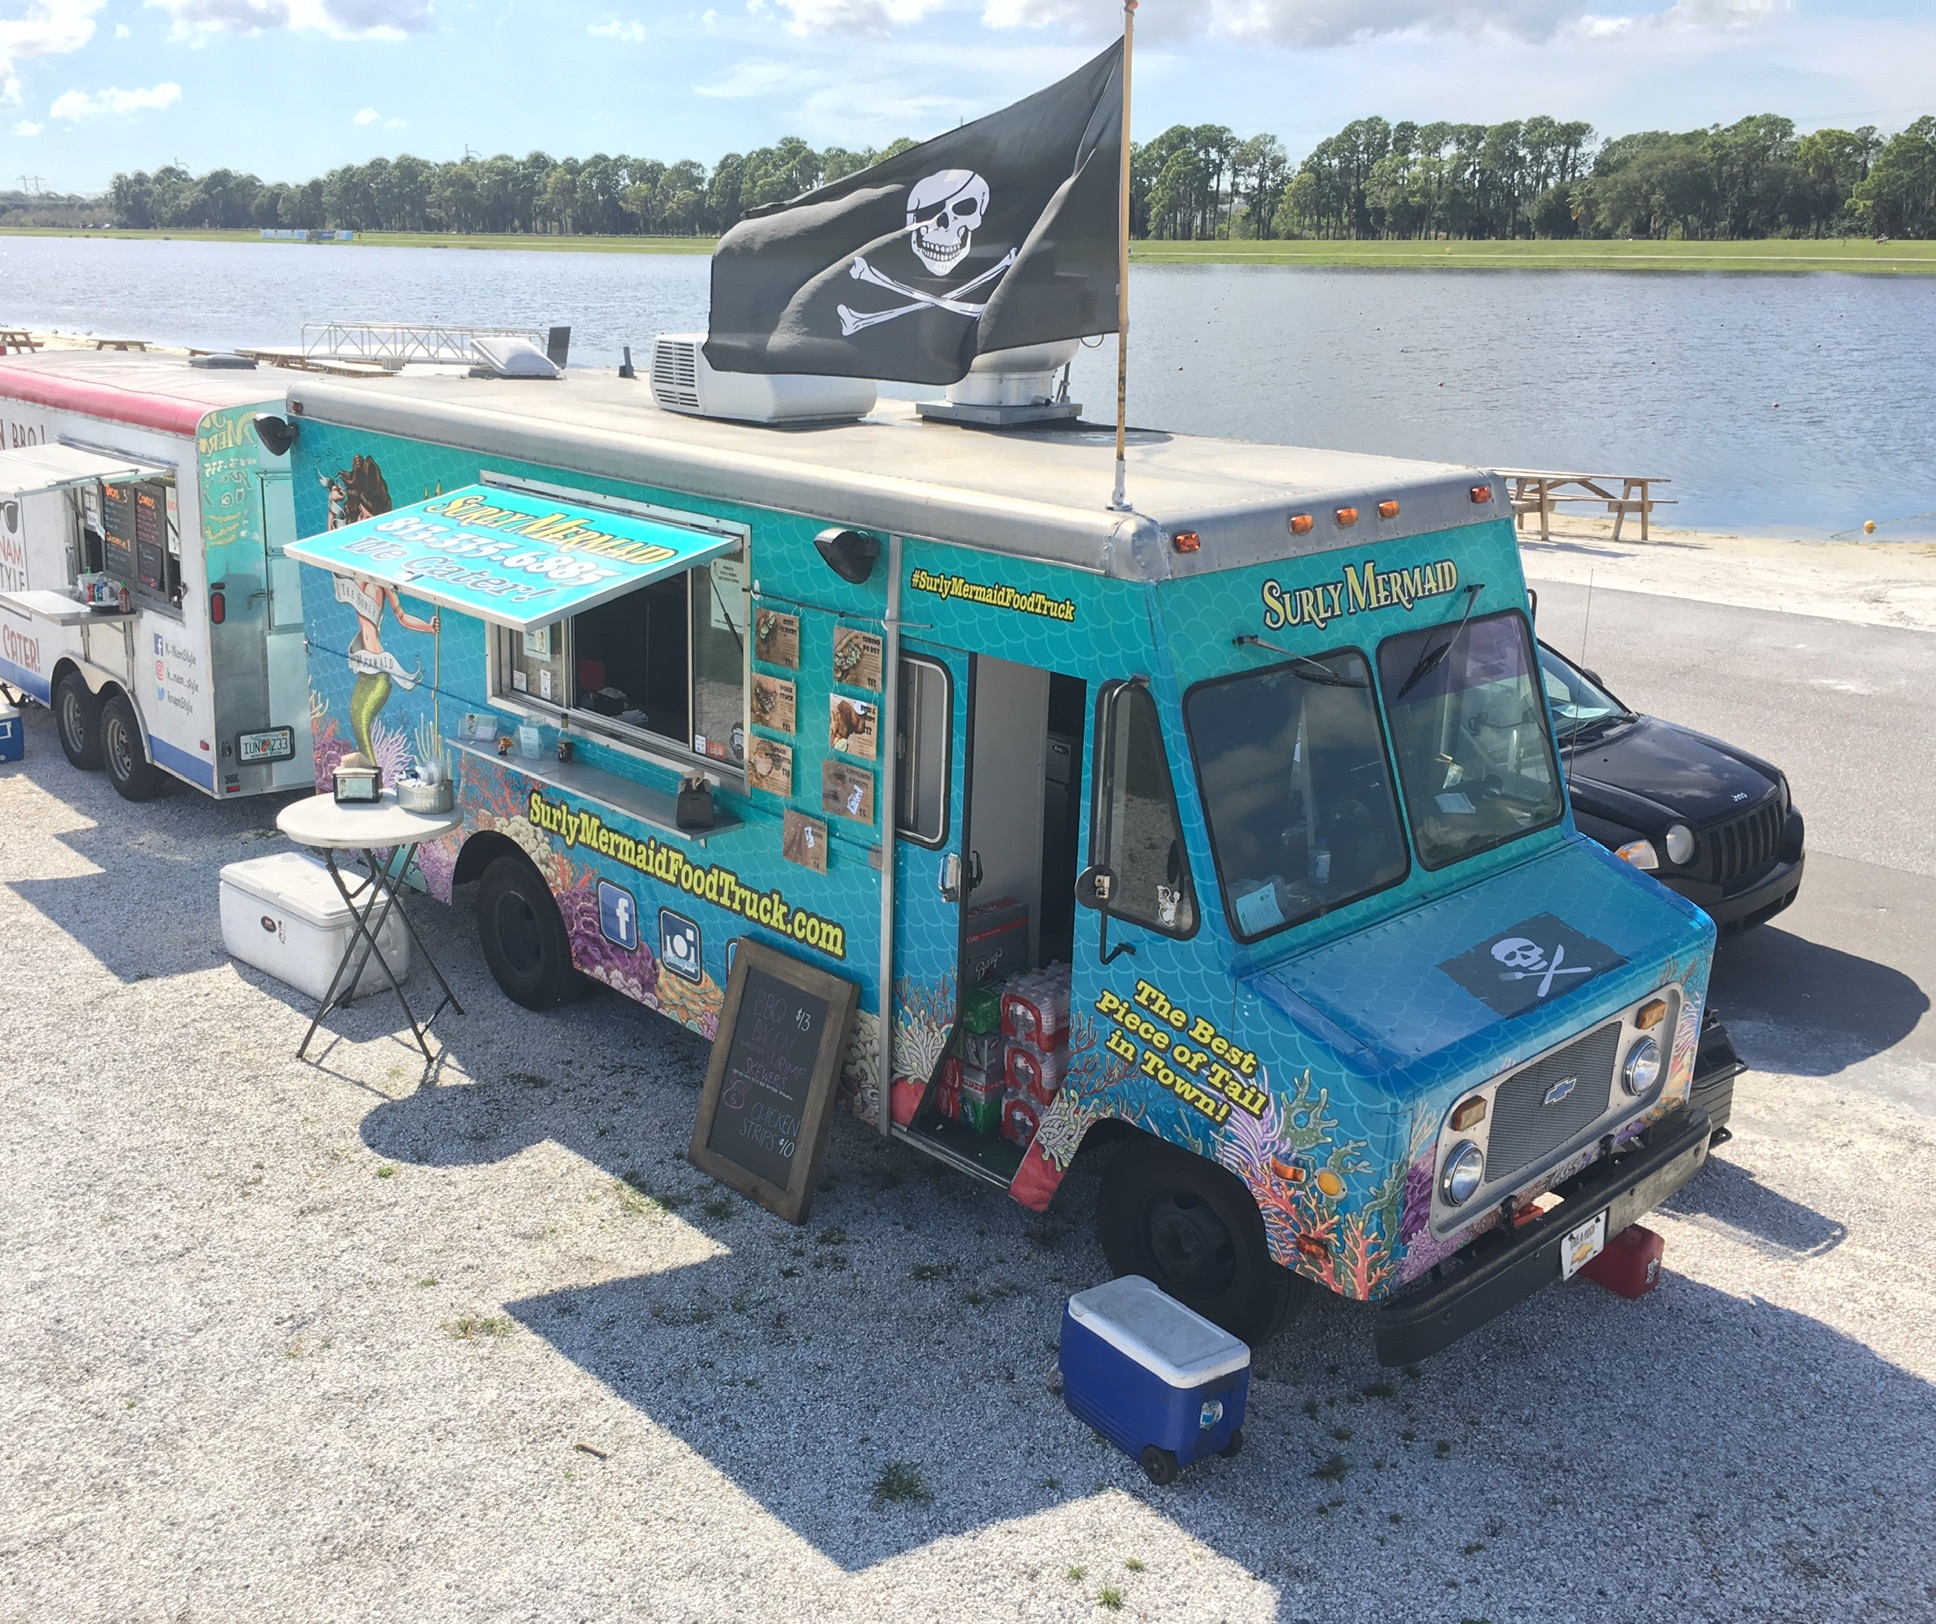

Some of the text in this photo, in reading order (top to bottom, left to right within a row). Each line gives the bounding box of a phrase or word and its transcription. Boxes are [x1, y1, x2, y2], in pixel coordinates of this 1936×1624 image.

[426, 495, 679, 564] SURLY MERMAID
[342, 537, 556, 602] We Cater!
[911, 569, 1076, 621] #SurlyMermaidFoodTruck
[1262, 560, 1458, 629] SURLY MERMAID
[3, 624, 41, 673] CATER!
[530, 793, 844, 957] SurlyMermaidFoodTruck.com
[752, 1018, 797, 1055] BACON
[754, 989, 812, 1032] BBQ $13
[1134, 980, 1257, 1074] The Best
[743, 1057, 788, 1091] SKEWERS
[1096, 990, 1267, 1115] Piece of Tail
[1106, 1030, 1230, 1122] in Town!
[739, 1118, 795, 1158] STRIPS $10
[751, 1102, 801, 1137] CHICKEN
